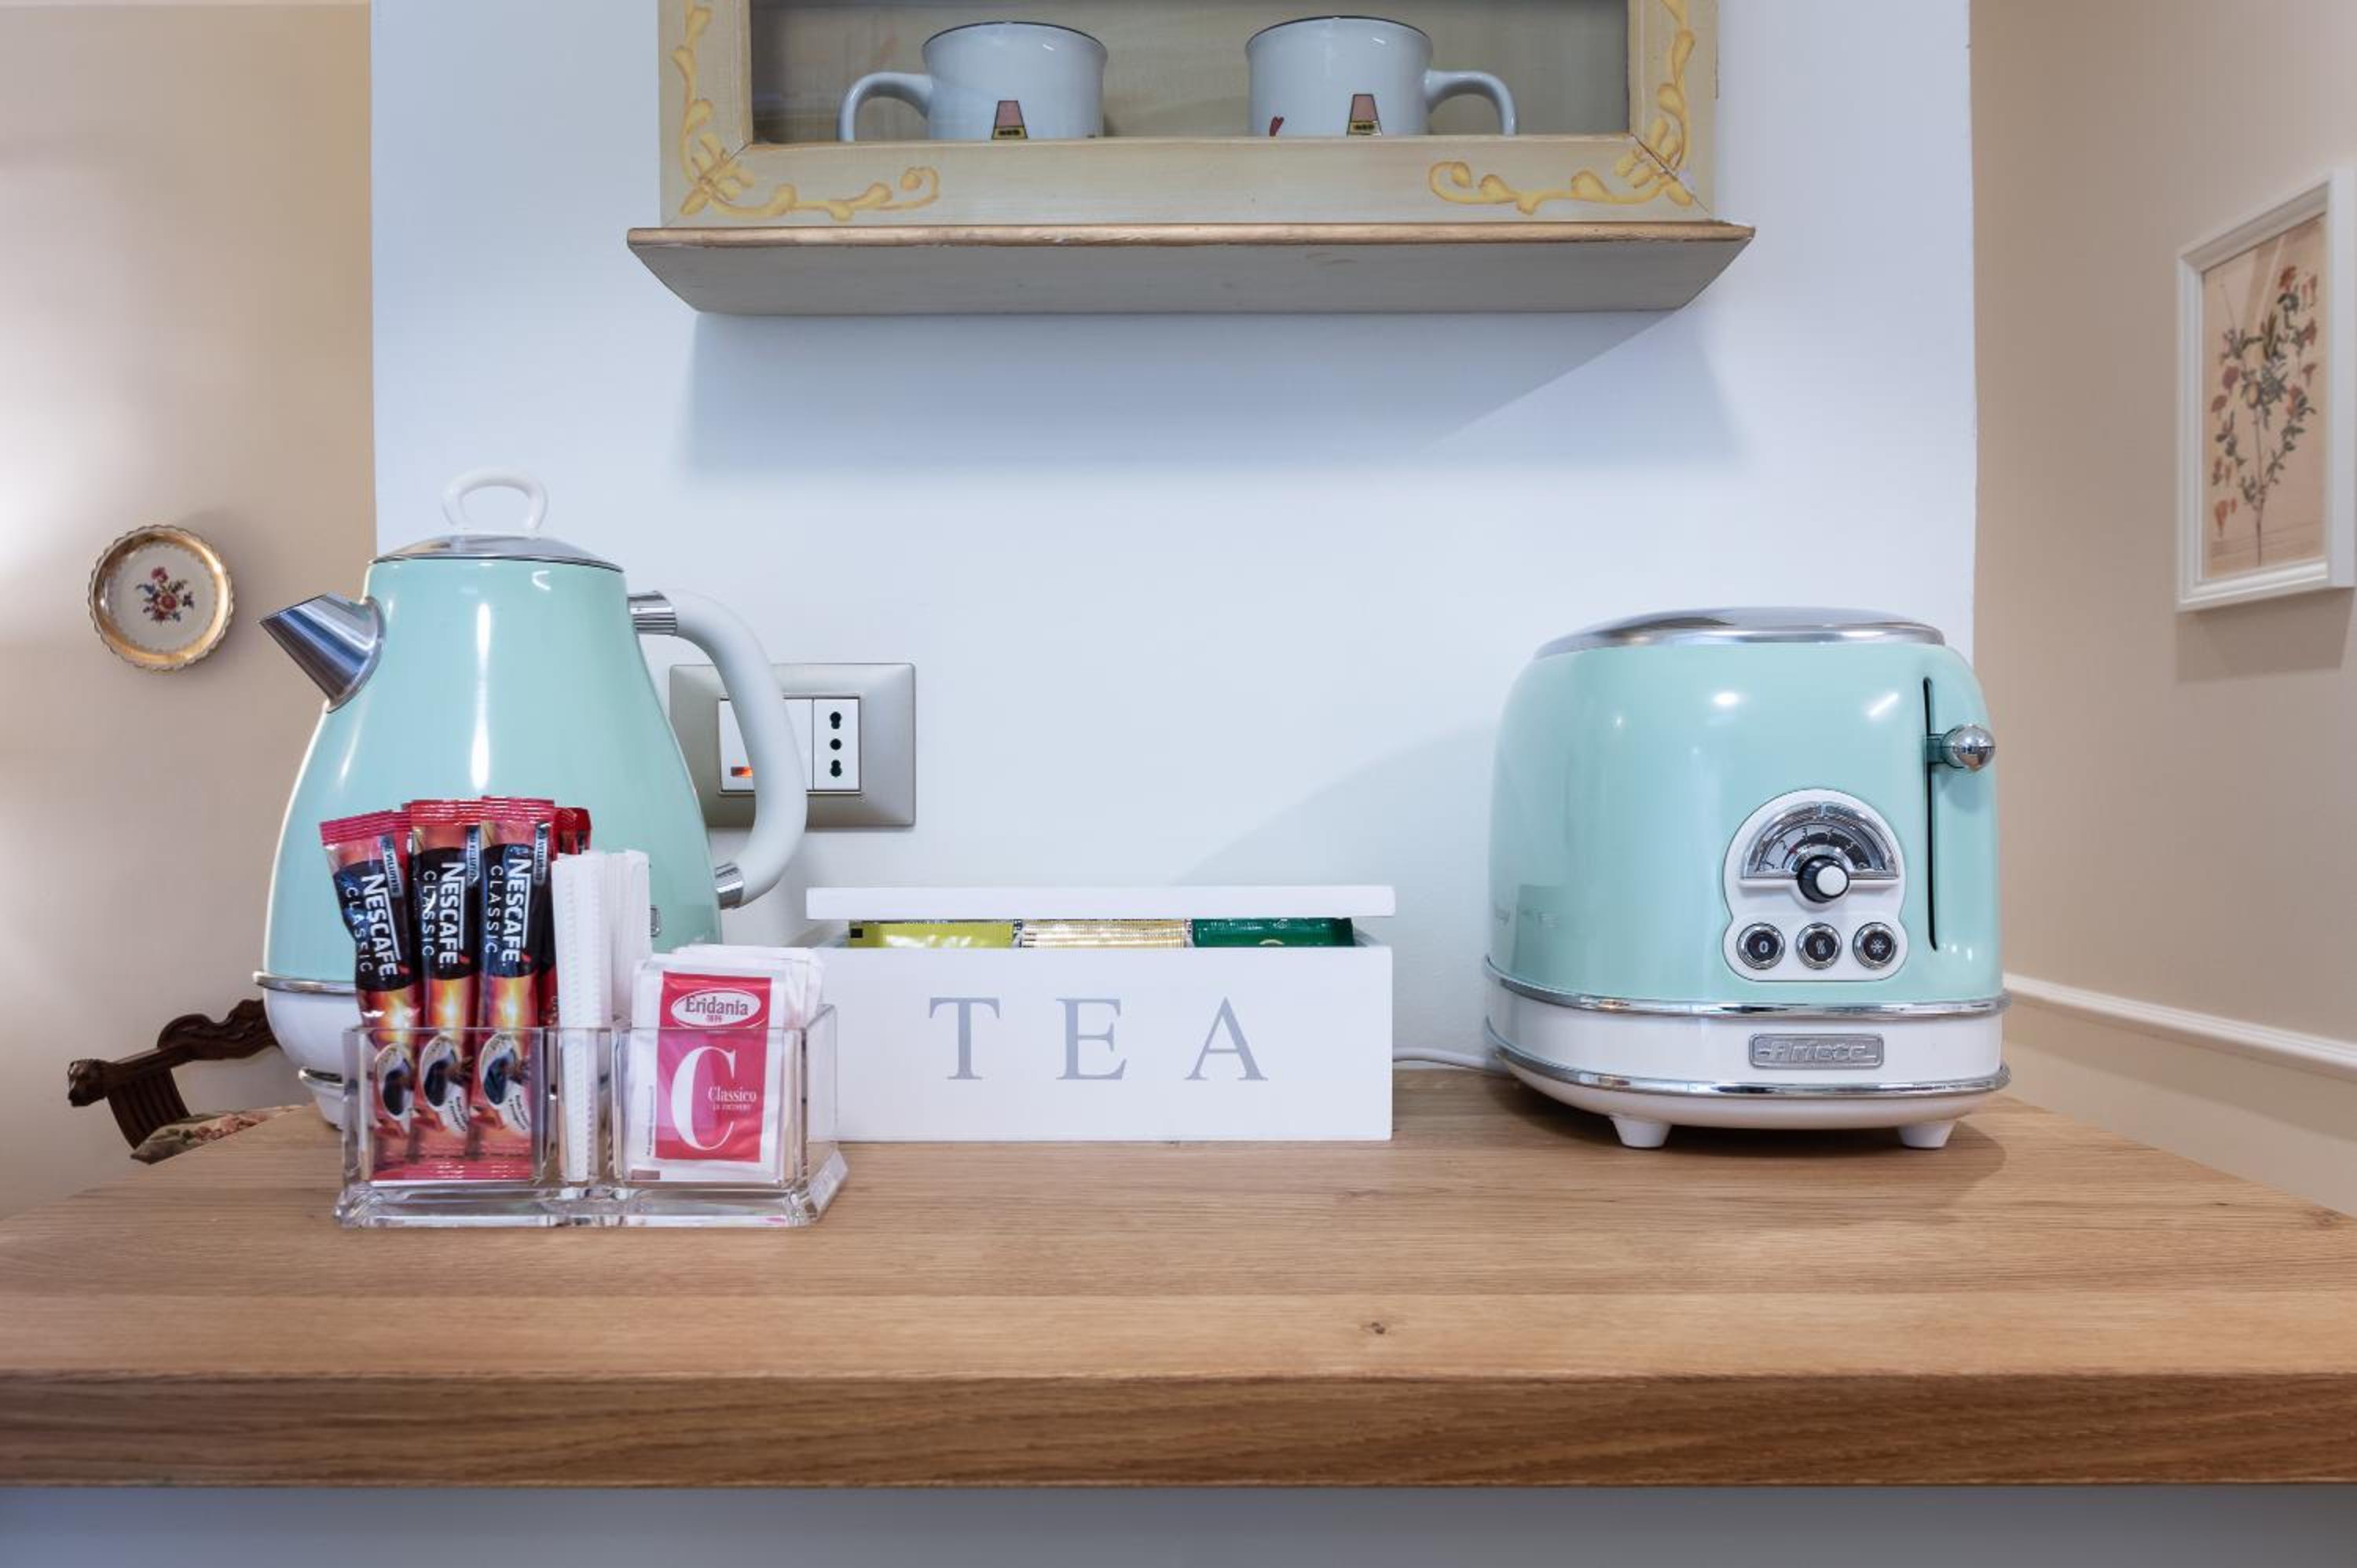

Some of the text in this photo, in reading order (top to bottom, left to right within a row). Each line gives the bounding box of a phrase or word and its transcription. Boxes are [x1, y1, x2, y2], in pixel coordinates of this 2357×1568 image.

[346, 887, 374, 973] CLASSIC
[422, 870, 438, 957] CLASSIC
[485, 865, 504, 954] CLASSIC
[684, 995, 749, 1016] Eridania
[670, 1046, 736, 1151] C
[708, 1086, 757, 1103] Classico
